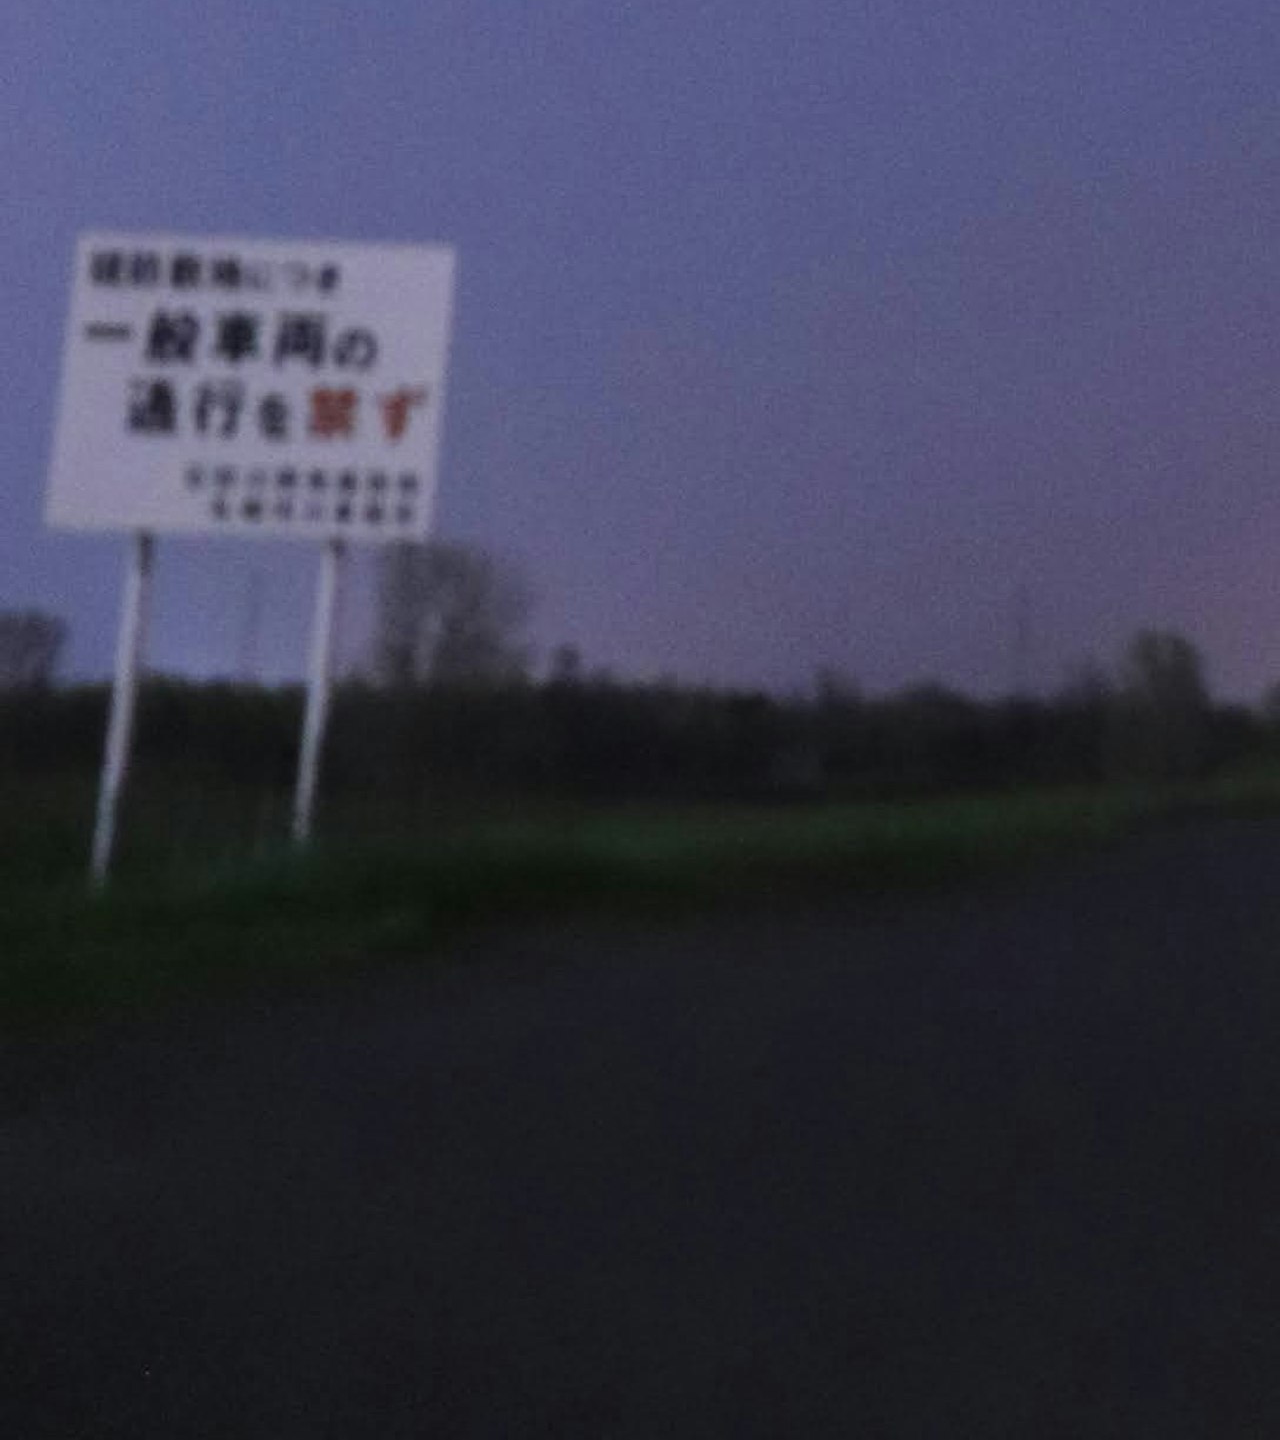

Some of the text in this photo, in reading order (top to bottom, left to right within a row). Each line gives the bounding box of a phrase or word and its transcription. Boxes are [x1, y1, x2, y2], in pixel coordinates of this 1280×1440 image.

[84, 309, 379, 369] 一般車両の
[126, 378, 424, 440] 通行を禁ず
